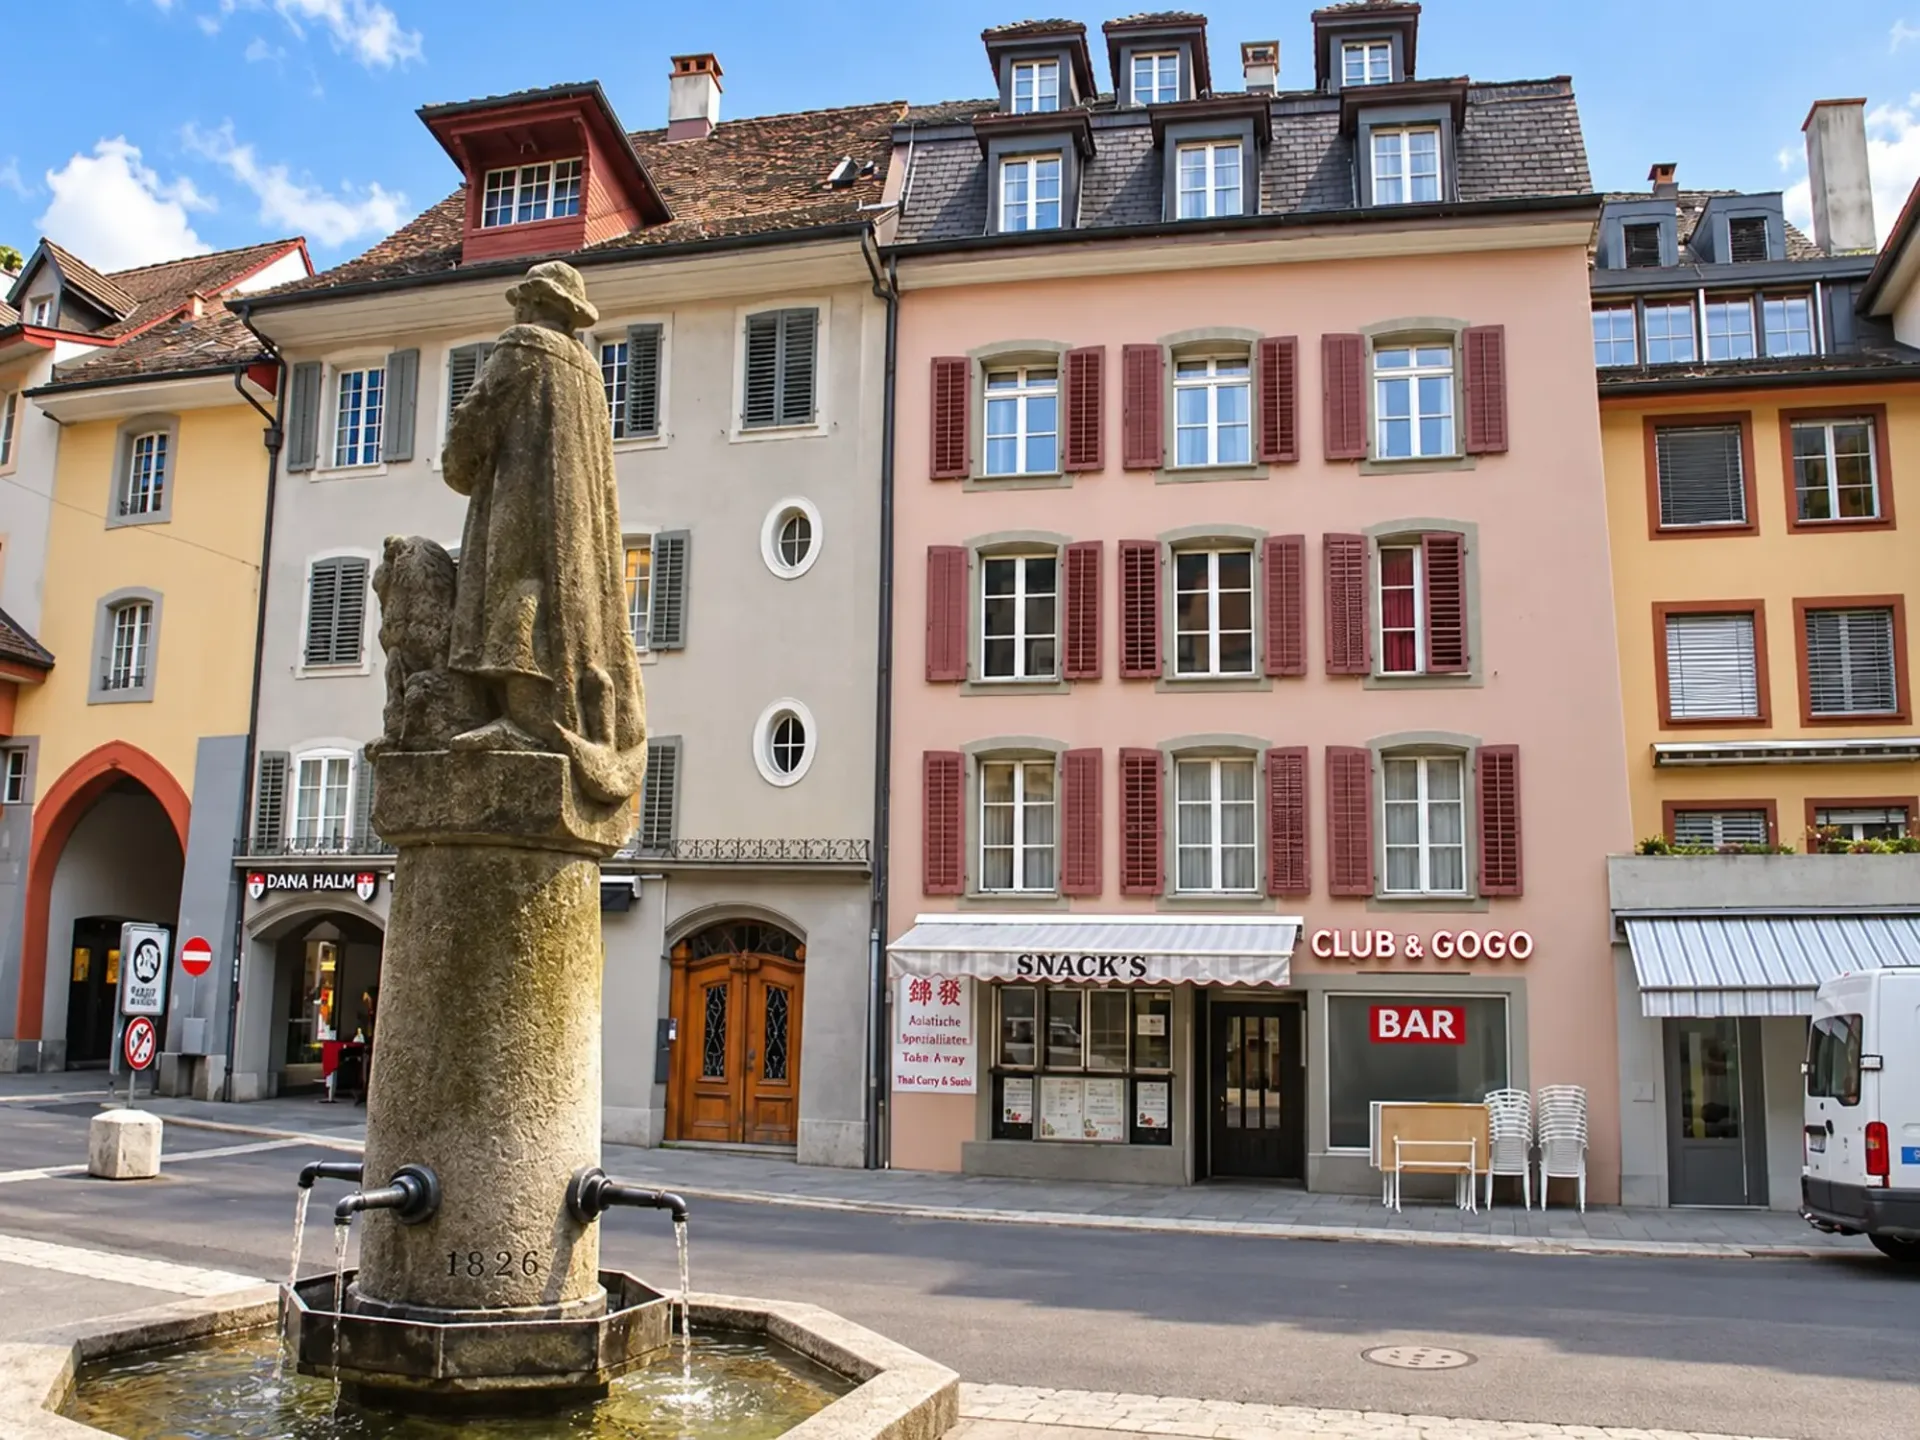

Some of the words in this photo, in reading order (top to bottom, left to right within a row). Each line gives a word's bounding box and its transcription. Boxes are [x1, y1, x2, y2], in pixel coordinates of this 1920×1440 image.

[267, 873, 309, 889] DANA
[313, 873, 355, 889] HALM
[1311, 930, 1396, 958] CLUB
[1404, 933, 1424, 958] &
[1431, 930, 1534, 959] GOGO
[1017, 953, 1147, 977] SNACK'S
[1378, 1009, 1456, 1039] BAR
[897, 1075, 915, 1085] Thai
[447, 1250, 538, 1277] 1826
